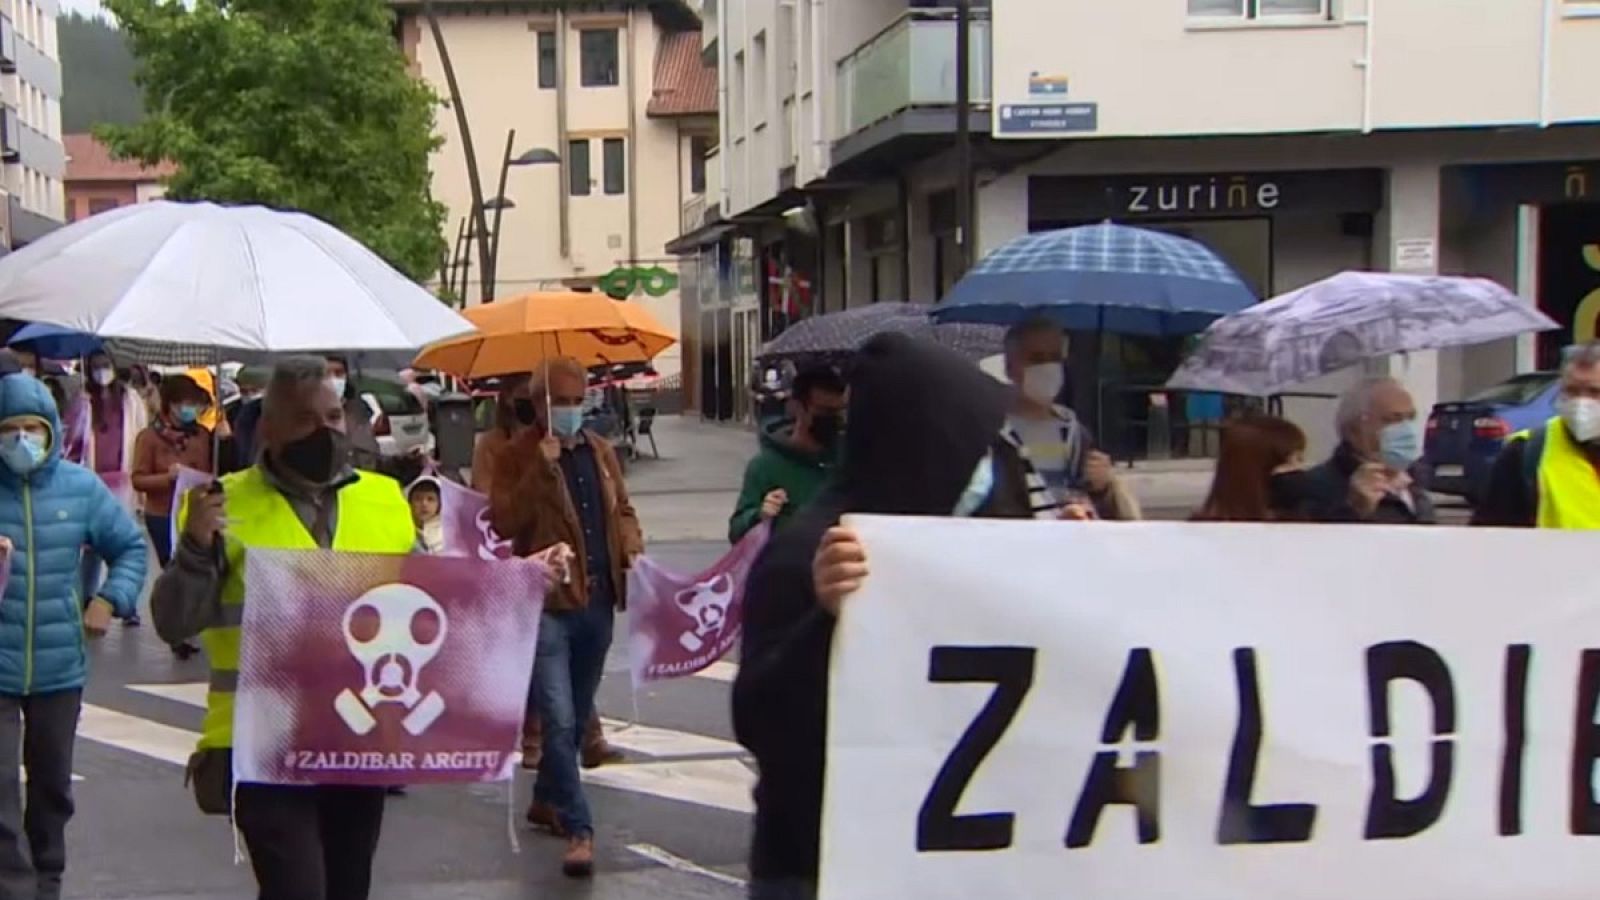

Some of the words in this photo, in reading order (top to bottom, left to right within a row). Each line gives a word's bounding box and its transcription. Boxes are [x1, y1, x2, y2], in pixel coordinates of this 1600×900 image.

[1128, 177, 1279, 211] zuriñe
[284, 751, 415, 770] #ZALDIBAR
[421, 751, 500, 769] ARGITU
